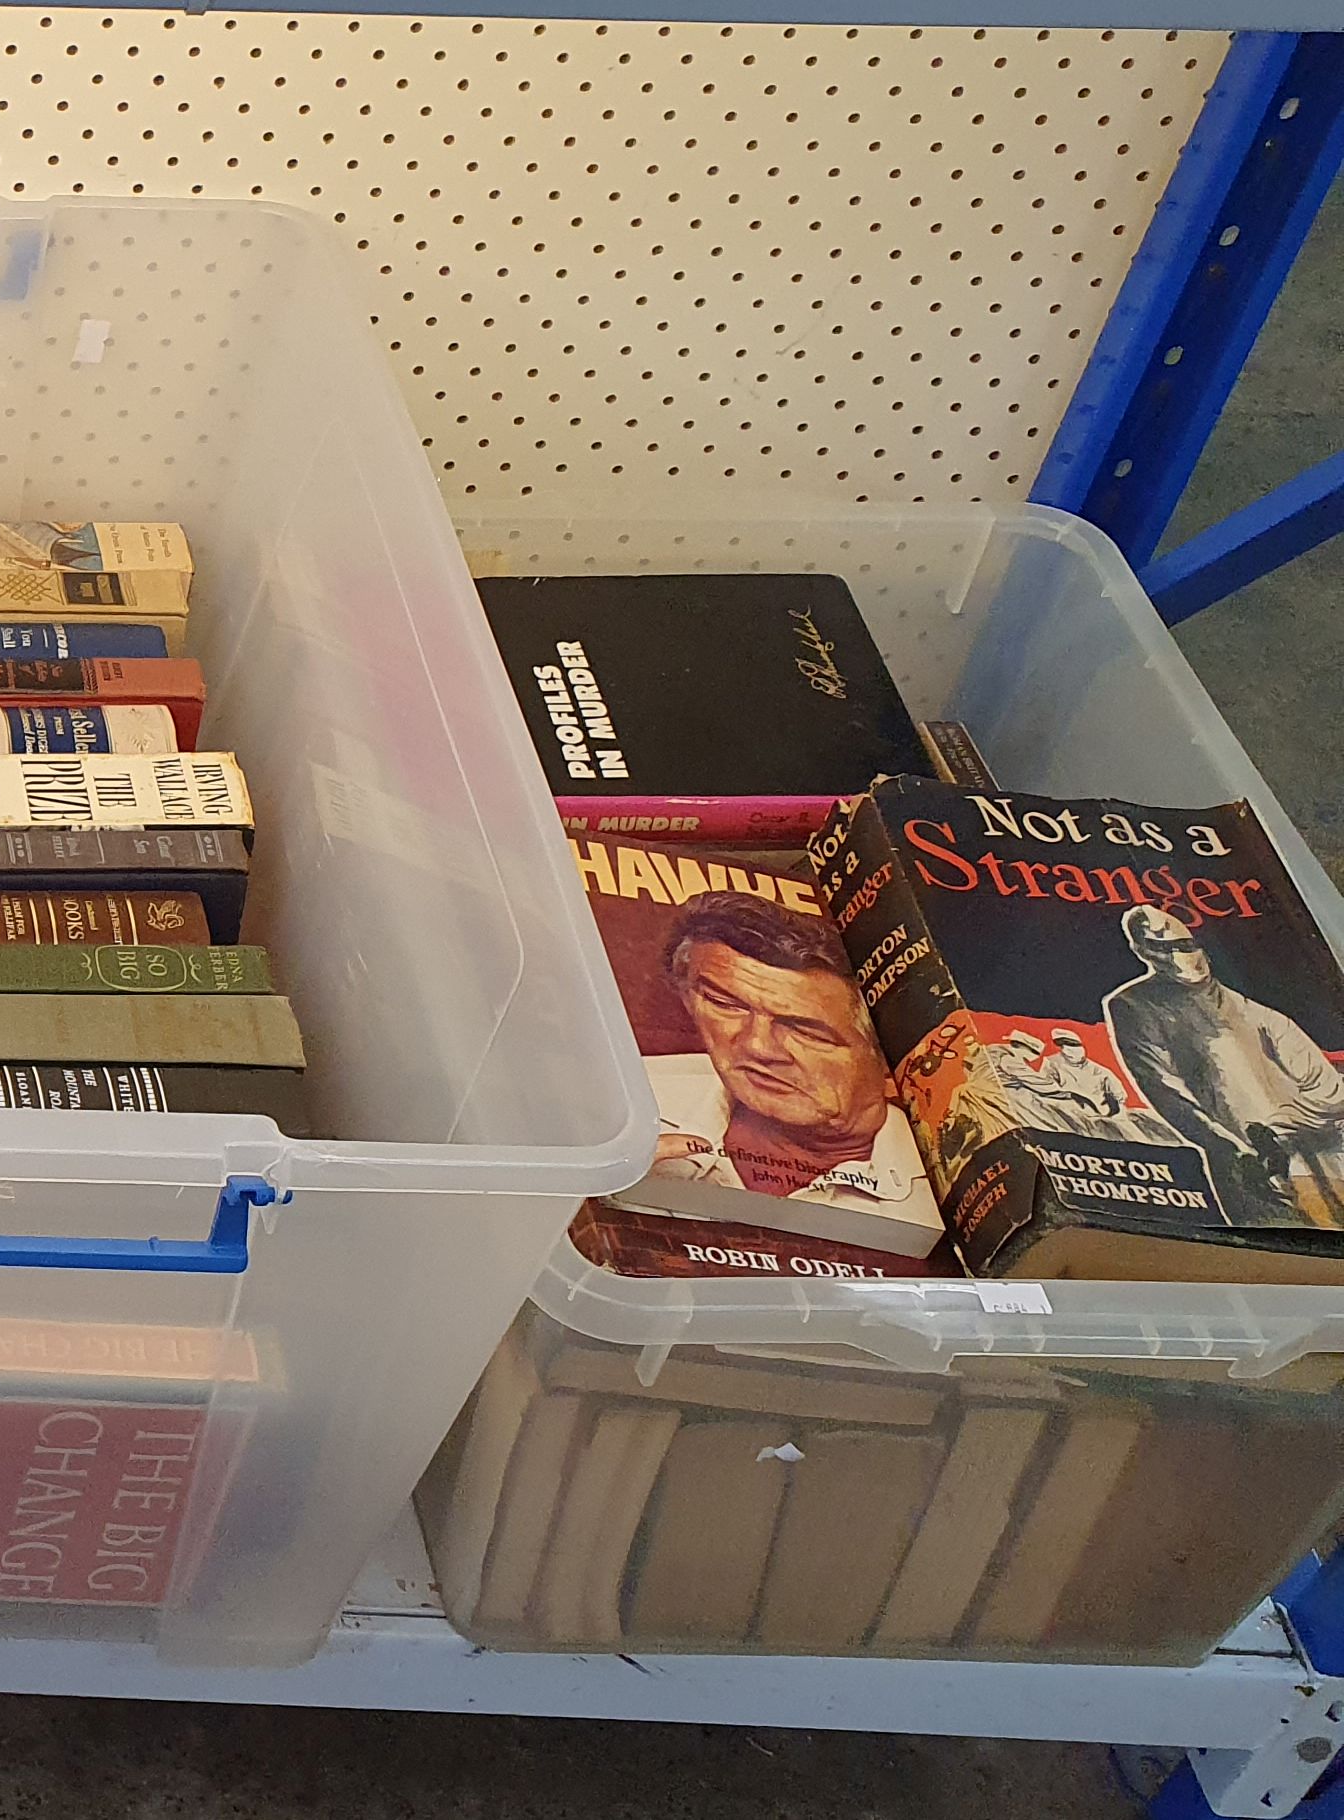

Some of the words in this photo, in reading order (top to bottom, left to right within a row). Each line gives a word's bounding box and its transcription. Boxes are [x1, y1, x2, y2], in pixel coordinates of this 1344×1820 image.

[0, 627, 16, 649] Shall
[20, 629, 34, 647] You
[556, 640, 617, 740] MURDER
[532, 664, 597, 780] PROFILES
[595, 749, 630, 779] IN
[20, 760, 95, 823] PRIZE
[92, 772, 138, 807] THE
[152, 758, 196, 820] WALLACE
[191, 764, 234, 816] IRVING
[597, 815, 701, 832] MURDER
[966, 795, 1094, 845] Not
[1104, 813, 1175, 854] as
[1184, 824, 1233, 858] a
[809, 826, 851, 872] Not
[843, 852, 862, 874] a
[836, 862, 894, 932] ranger
[902, 819, 1263, 929] Stranger
[116, 950, 142, 981] BIG
[145, 954, 168, 977] SO
[207, 945, 229, 991] FERBER
[225, 951, 244, 983] EDNA
[865, 937, 931, 1009] OMPSON
[81, 1069, 98, 1087] THE
[117, 1075, 135, 1112] WHITE
[686, 1140, 713, 1155] the
[795, 1158, 879, 1191] biography
[752, 1168, 784, 1185] John
[1041, 1144, 1176, 1183] MORTON
[951, 1159, 1010, 1224] MICHAEL
[961, 1182, 1009, 1244] JOSEPH
[1052, 1171, 1209, 1210] THOMPSON
[682, 1243, 781, 1272] ROBIN
[113, 1429, 199, 1512] THE
[87, 1523, 170, 1594] BIG
